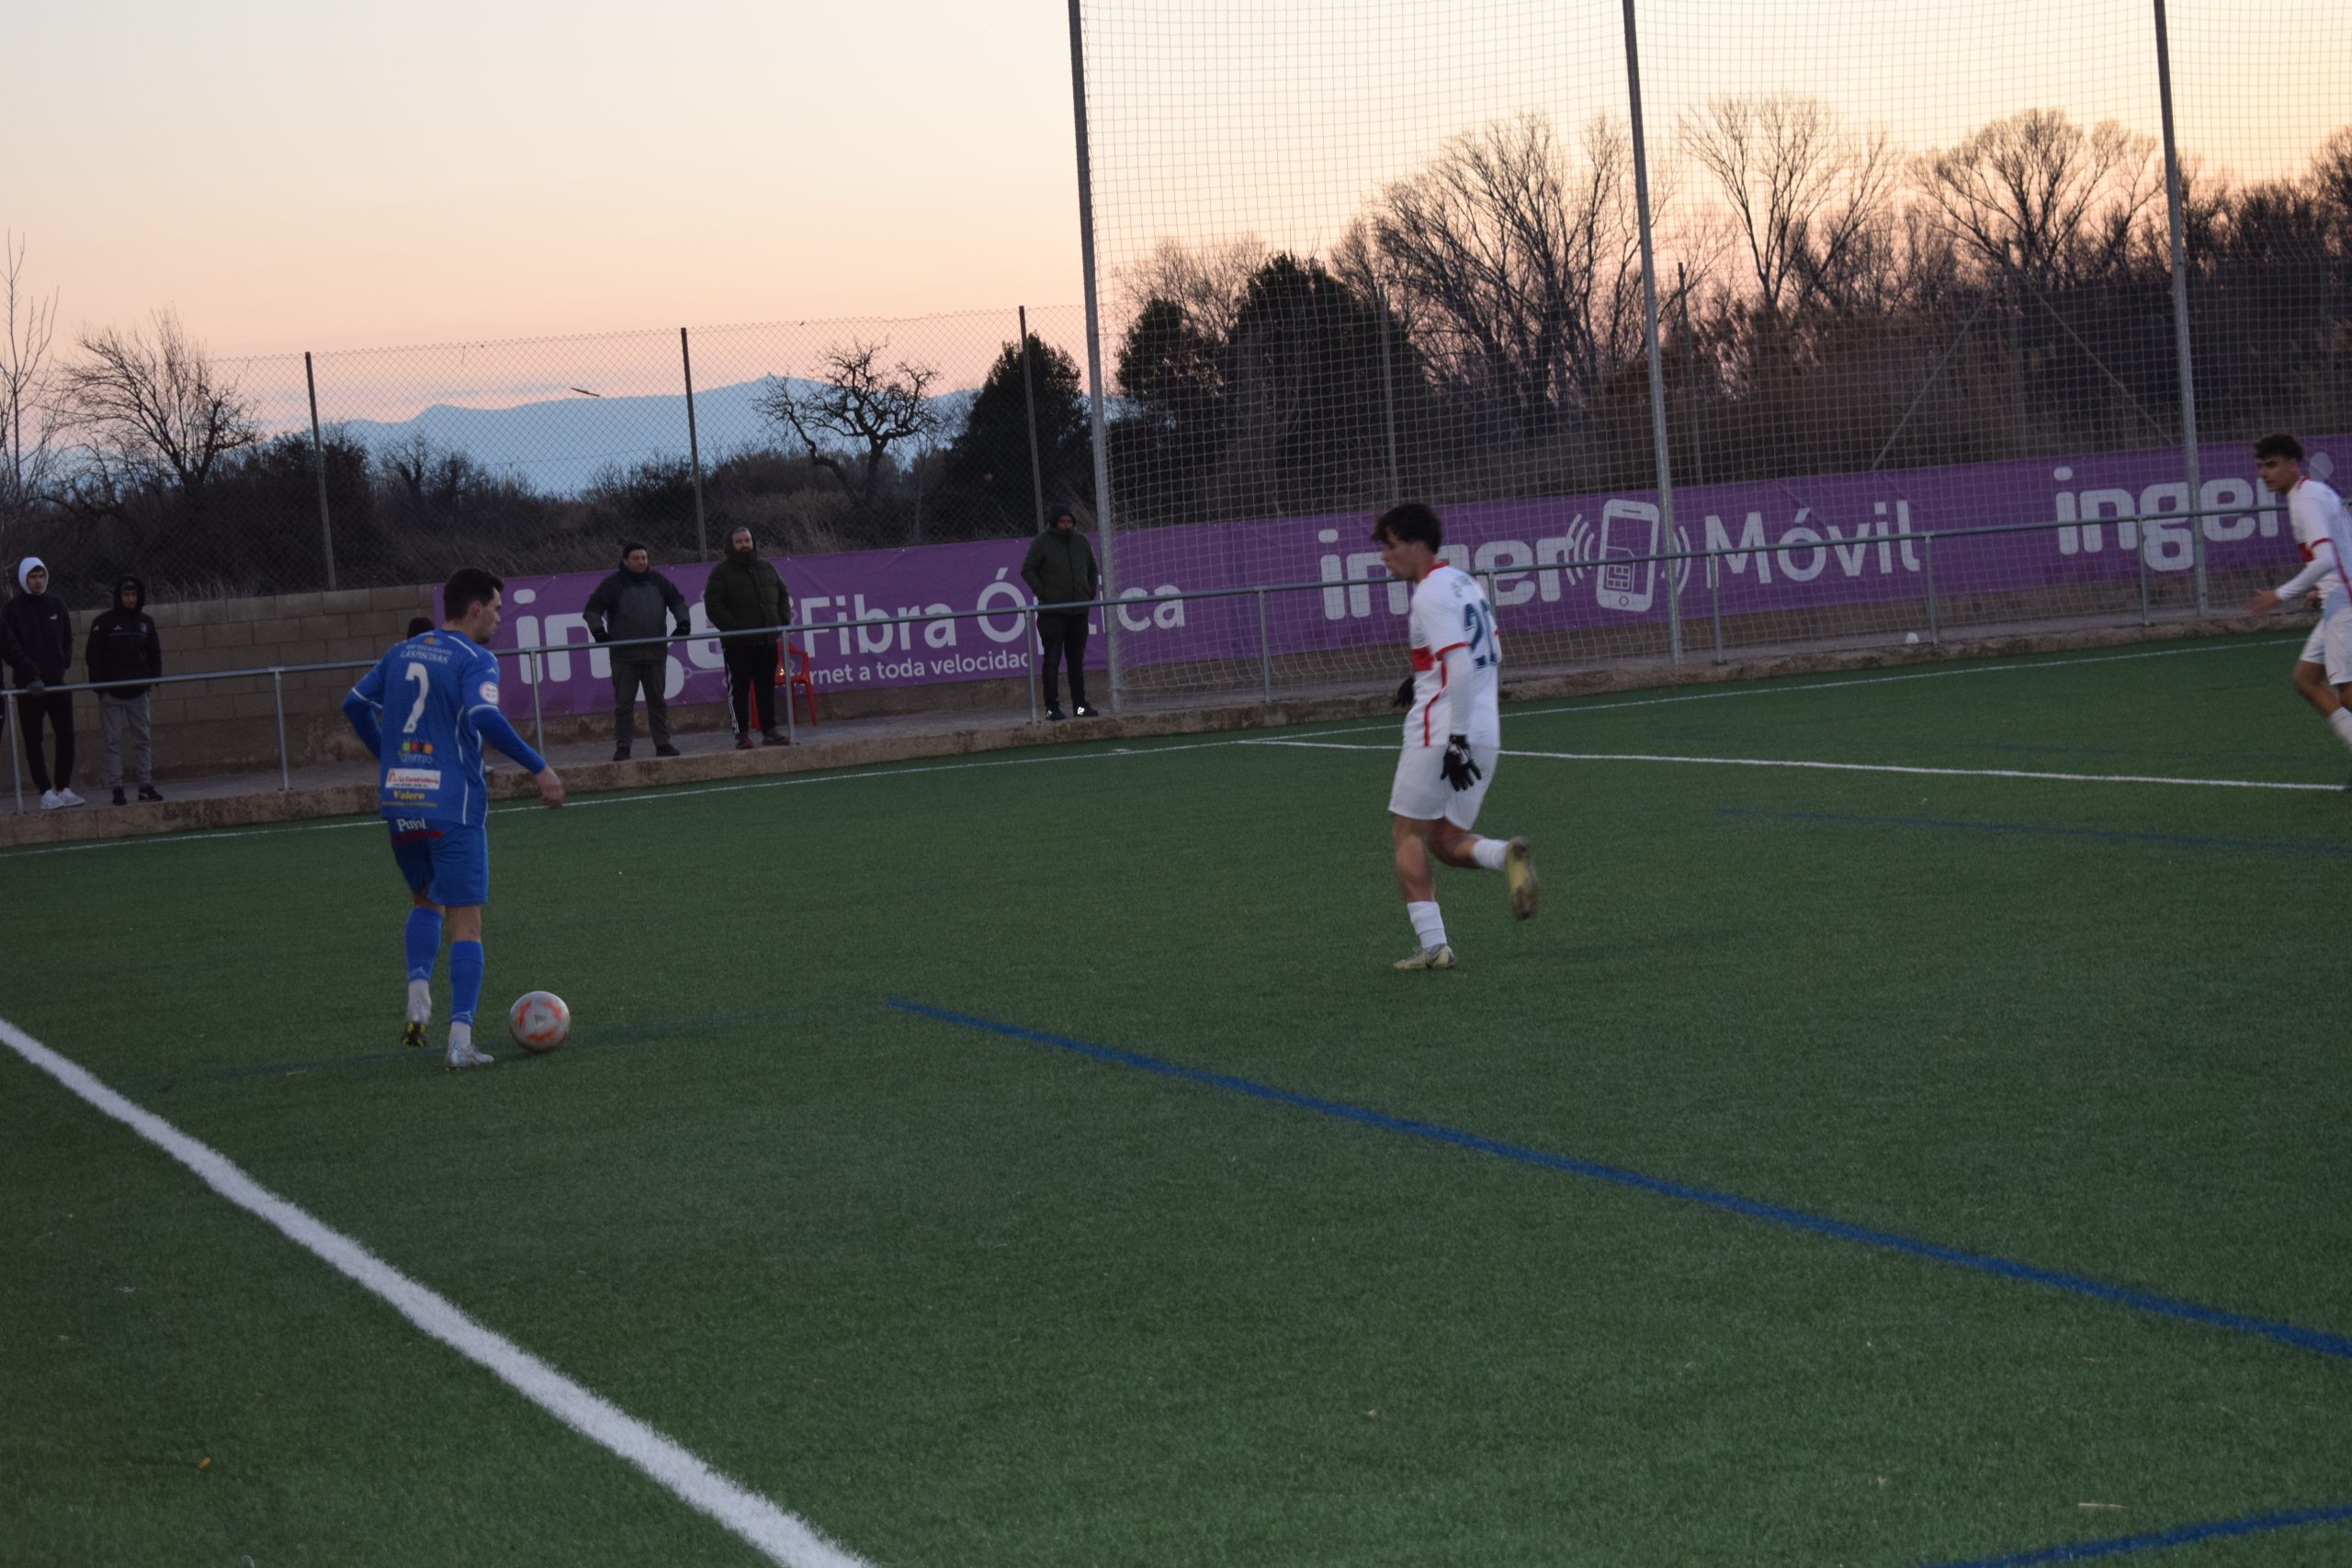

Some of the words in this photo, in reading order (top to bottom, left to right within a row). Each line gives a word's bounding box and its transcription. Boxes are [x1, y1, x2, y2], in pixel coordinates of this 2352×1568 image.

[1317, 528, 1576, 621] iner
[1705, 500, 1921, 589] Móvil
[800, 594, 957, 659] Fibra
[859, 664, 871, 682] a
[876, 658, 926, 680] toda
